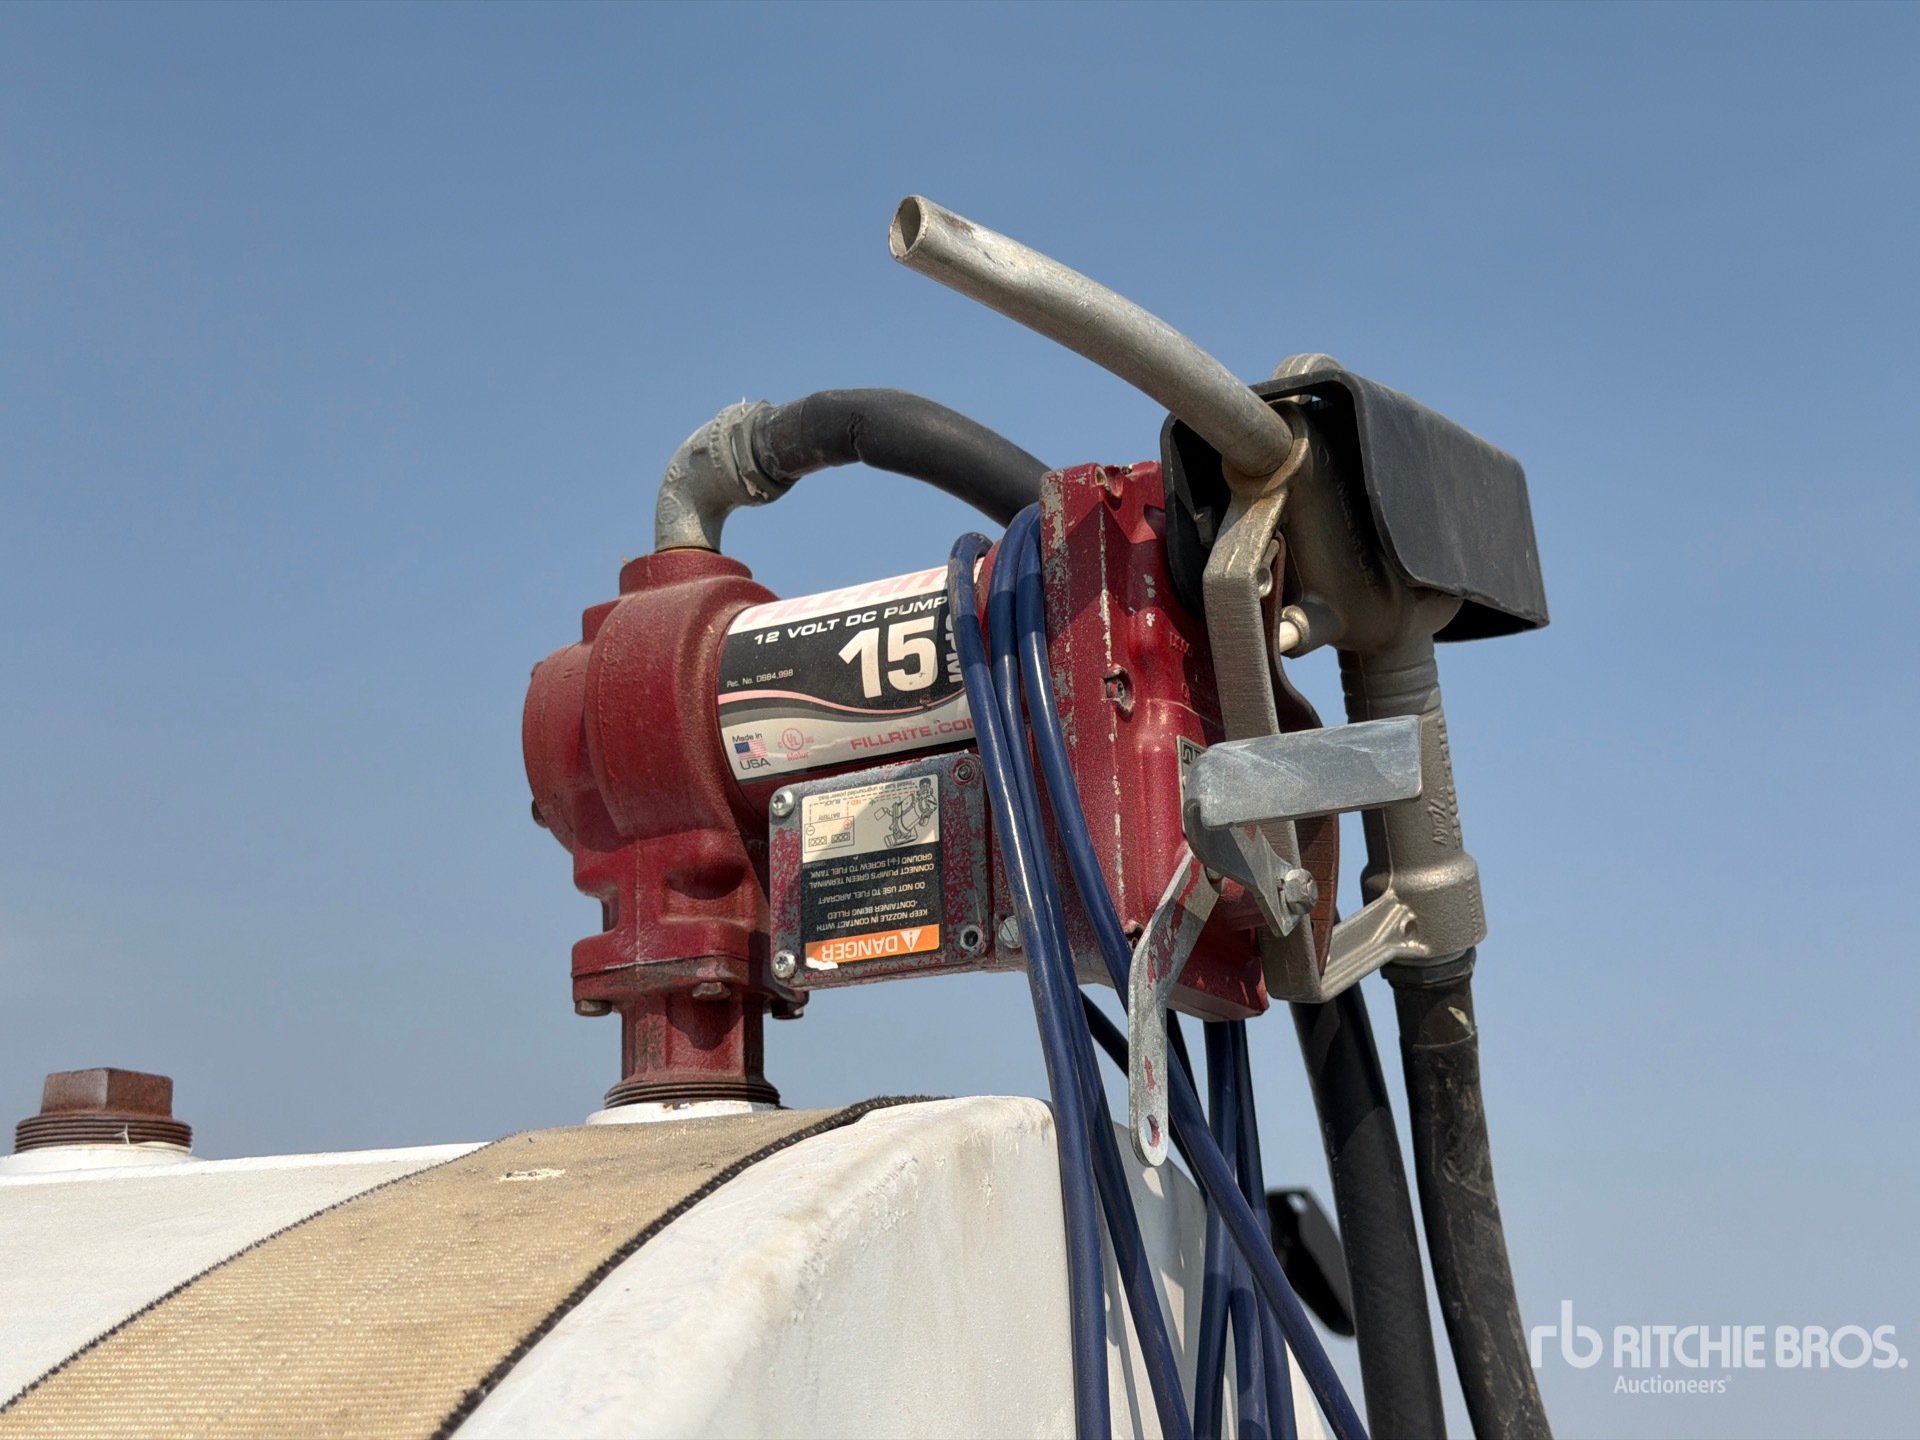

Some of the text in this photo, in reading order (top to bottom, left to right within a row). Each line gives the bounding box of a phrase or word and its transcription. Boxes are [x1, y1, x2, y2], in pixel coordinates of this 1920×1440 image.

[741, 567, 948, 627] FILL-RIT
[754, 596, 948, 645] 12 VOLT DC PUMP
[838, 615, 939, 699] 15
[742, 677, 753, 685] No.
[732, 734, 755, 743] Made
[740, 757, 771, 771] USA
[810, 853, 933, 879] GROUND SCREW TO FUEL TANK
[899, 863, 935, 875] CONNECT
[808, 877, 845, 889] TERMINAL
[846, 873, 870, 883] GREEN
[817, 881, 926, 904] DO NOT USE TO FUEL AIRCRAFT
[816, 908, 928, 932] KEEP NOZZLE IN CONTACT WITH
[827, 900, 916, 919] CONTAINER BEING FILLED
[821, 935, 898, 961] DANGER
